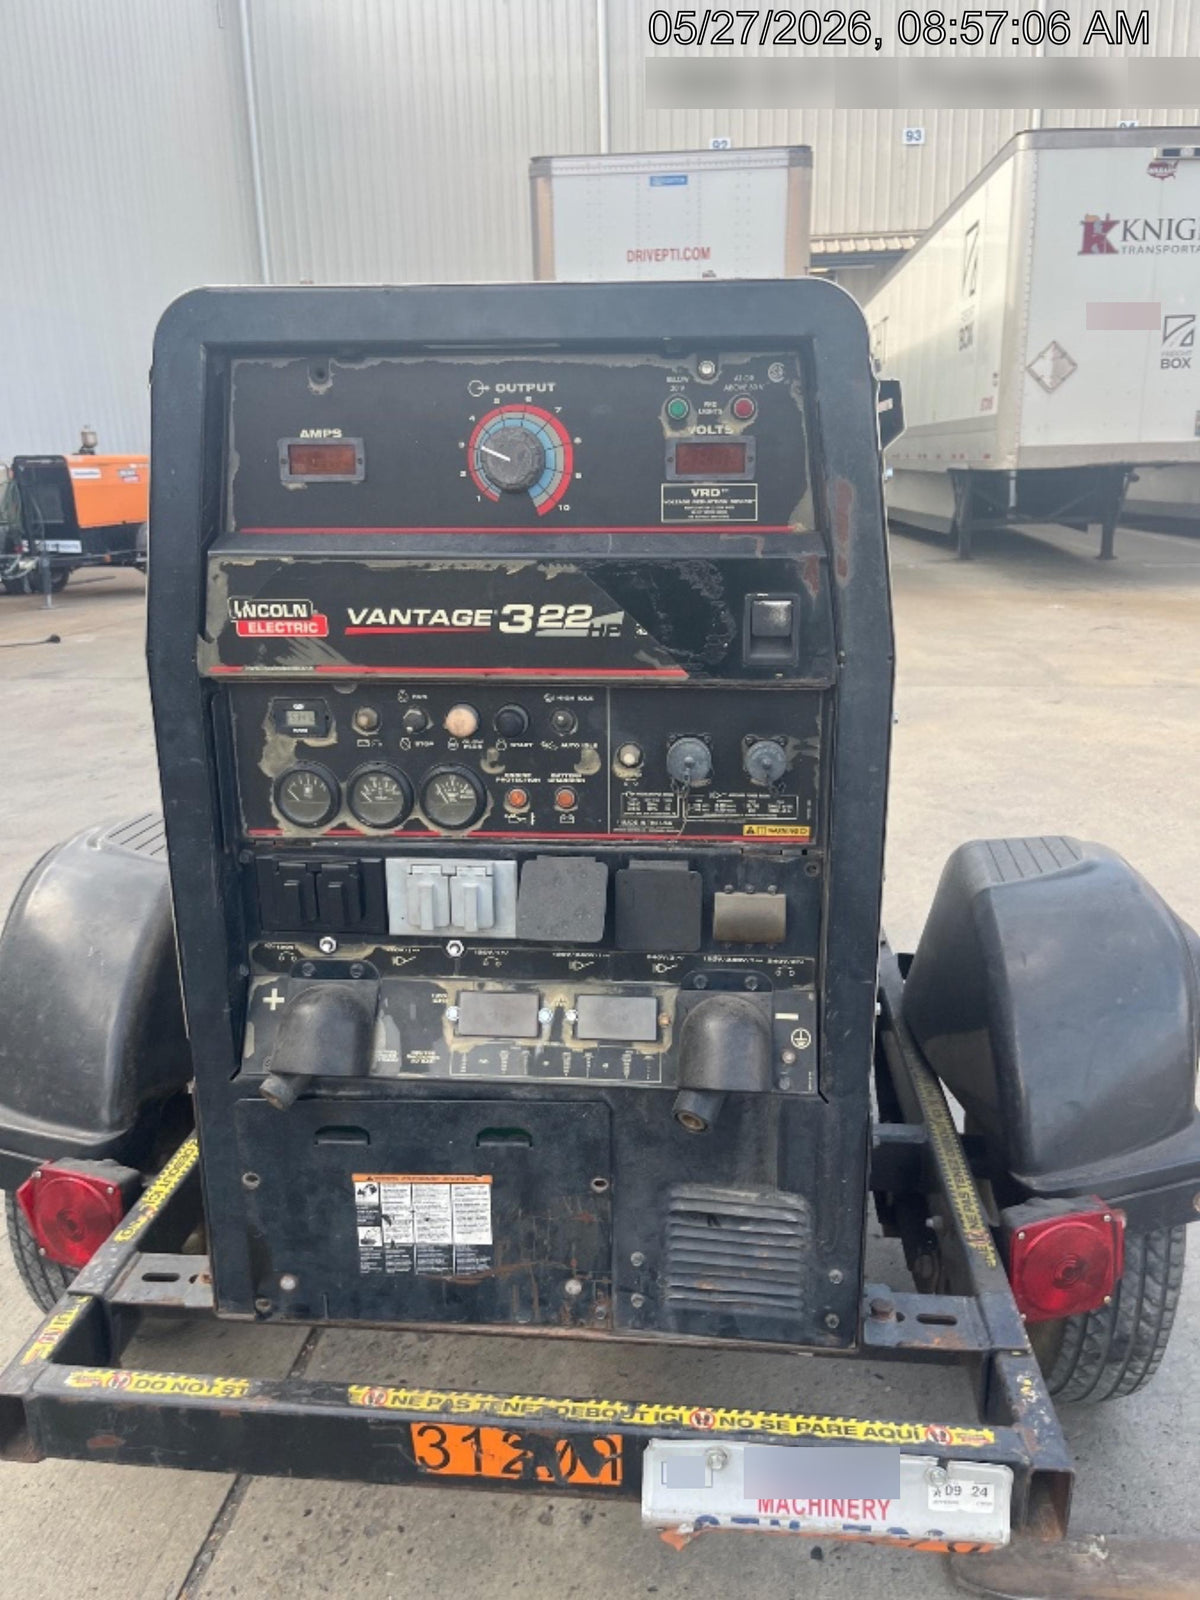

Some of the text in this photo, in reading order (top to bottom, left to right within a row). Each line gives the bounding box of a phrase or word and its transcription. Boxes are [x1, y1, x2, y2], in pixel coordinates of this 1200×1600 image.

[906, 130, 922, 142] 93
[1121, 217, 1200, 242] KNIG
[626, 247, 711, 263] DRIVEPTI.COM
[1160, 358, 1192, 369] BOX
[495, 383, 556, 393] OUTPUT
[299, 428, 343, 439] AMPS
[687, 424, 734, 435] VOLTS
[346, 607, 494, 627] VANTAGE
[499, 604, 594, 634] 322
[247, 620, 319, 634] ELECTRIC
[134, 1378, 166, 1391] DO
[170, 1381, 216, 1394] NOT
[391, 1394, 422, 1407] NE
[426, 1396, 471, 1409] PAS
[654, 1411, 684, 1422] ICI
[719, 1416, 754, 1429] NO
[759, 1418, 791, 1431] SE
[795, 1421, 858, 1437] PARE
[971, 1485, 988, 1498] 24
[758, 1498, 891, 1521] MACHINERY
